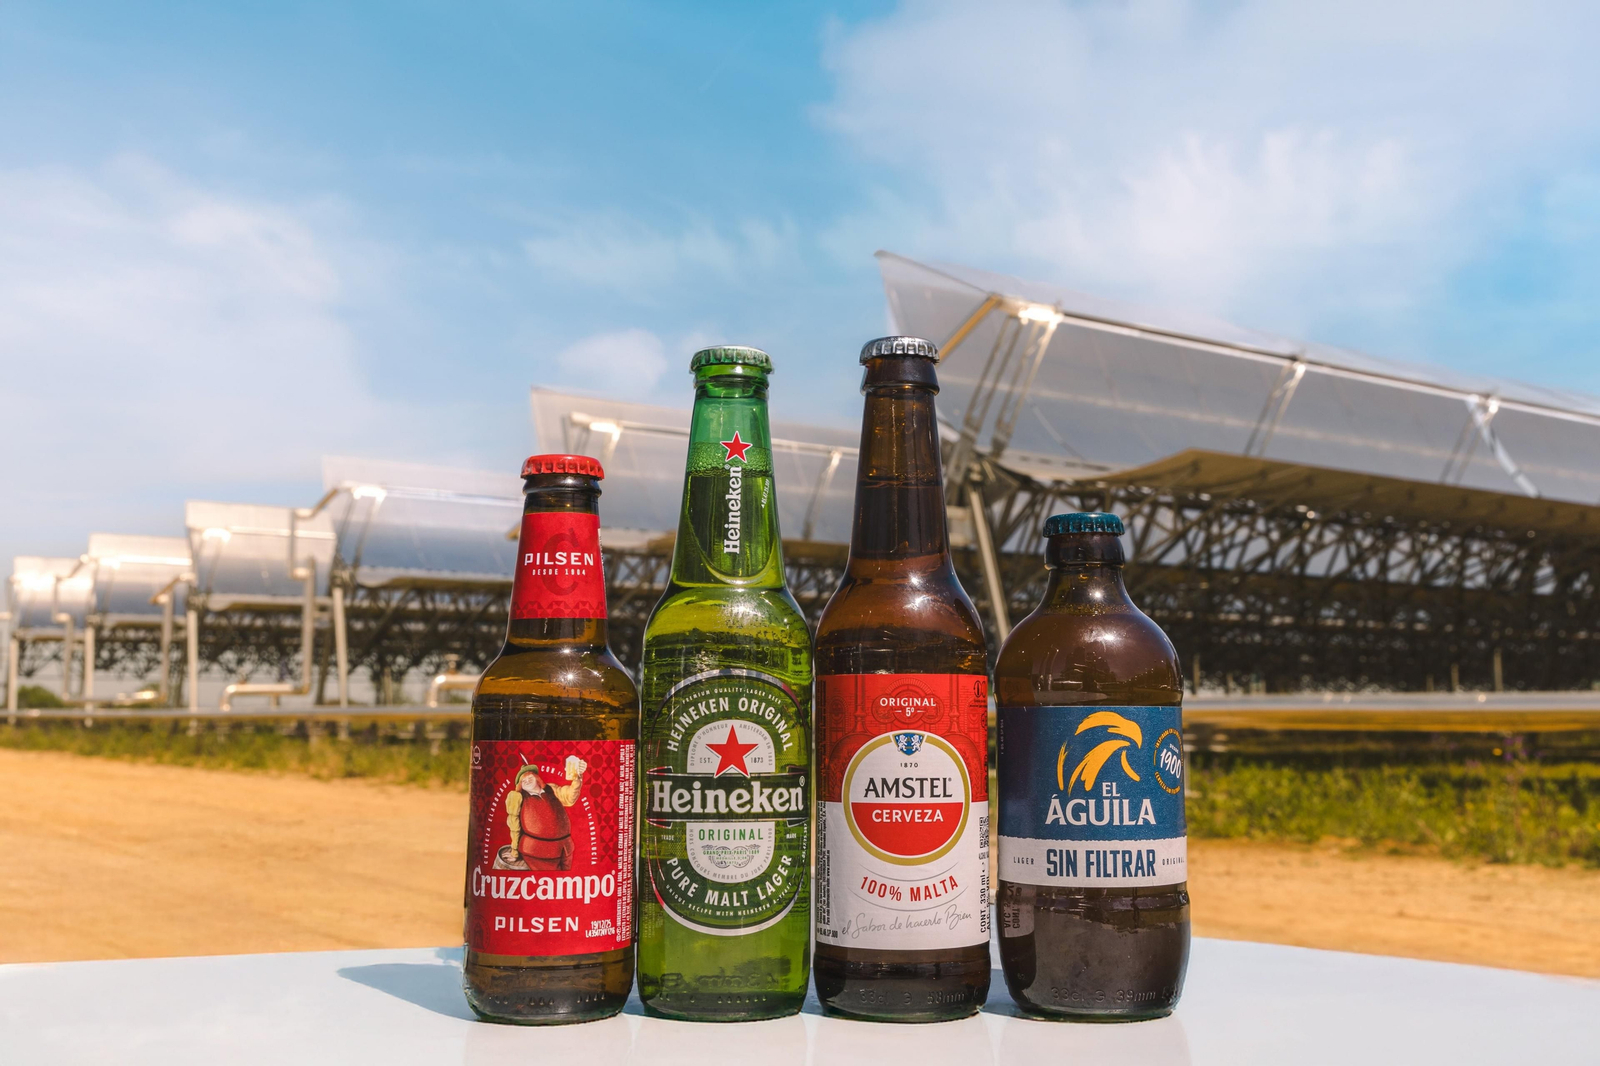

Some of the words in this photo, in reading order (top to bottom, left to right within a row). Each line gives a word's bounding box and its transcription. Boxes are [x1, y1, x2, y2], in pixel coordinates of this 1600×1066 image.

[724, 466, 742, 554] Heineken
[524, 552, 594, 566] PILSEN
[746, 688, 766, 696] LAGER
[880, 698, 936, 706] ORIGINAL
[667, 697, 729, 751] HEINEKEN
[738, 697, 793, 752] ORIGINAL
[540, 765, 554, 774] CON
[1160, 748, 1181, 778] 1900
[653, 781, 804, 814] Heineken
[864, 777, 952, 798] AMSTEL
[1102, 782, 1120, 797] EL
[872, 810, 944, 822] CERVEZA
[1045, 794, 1156, 825] ÁGUILA
[699, 829, 764, 840] ORIGINAL
[1013, 856, 1035, 865] LAGER
[1046, 849, 1077, 877] SIN
[1086, 849, 1156, 878] FILTRAR
[472, 865, 614, 904] Cruzcampo
[667, 857, 698, 898] PURE
[704, 889, 748, 907] MALT
[756, 855, 792, 900] LAGER
[861, 876, 901, 901] 100%
[910, 875, 958, 902] MALTA
[980, 875, 985, 885] ml
[688, 904, 712, 915] RECIPE
[842, 920, 852, 935] el
[889, 918, 902, 930] de
[945, 904, 972, 930] Bien
[495, 916, 579, 933] PILSEN
